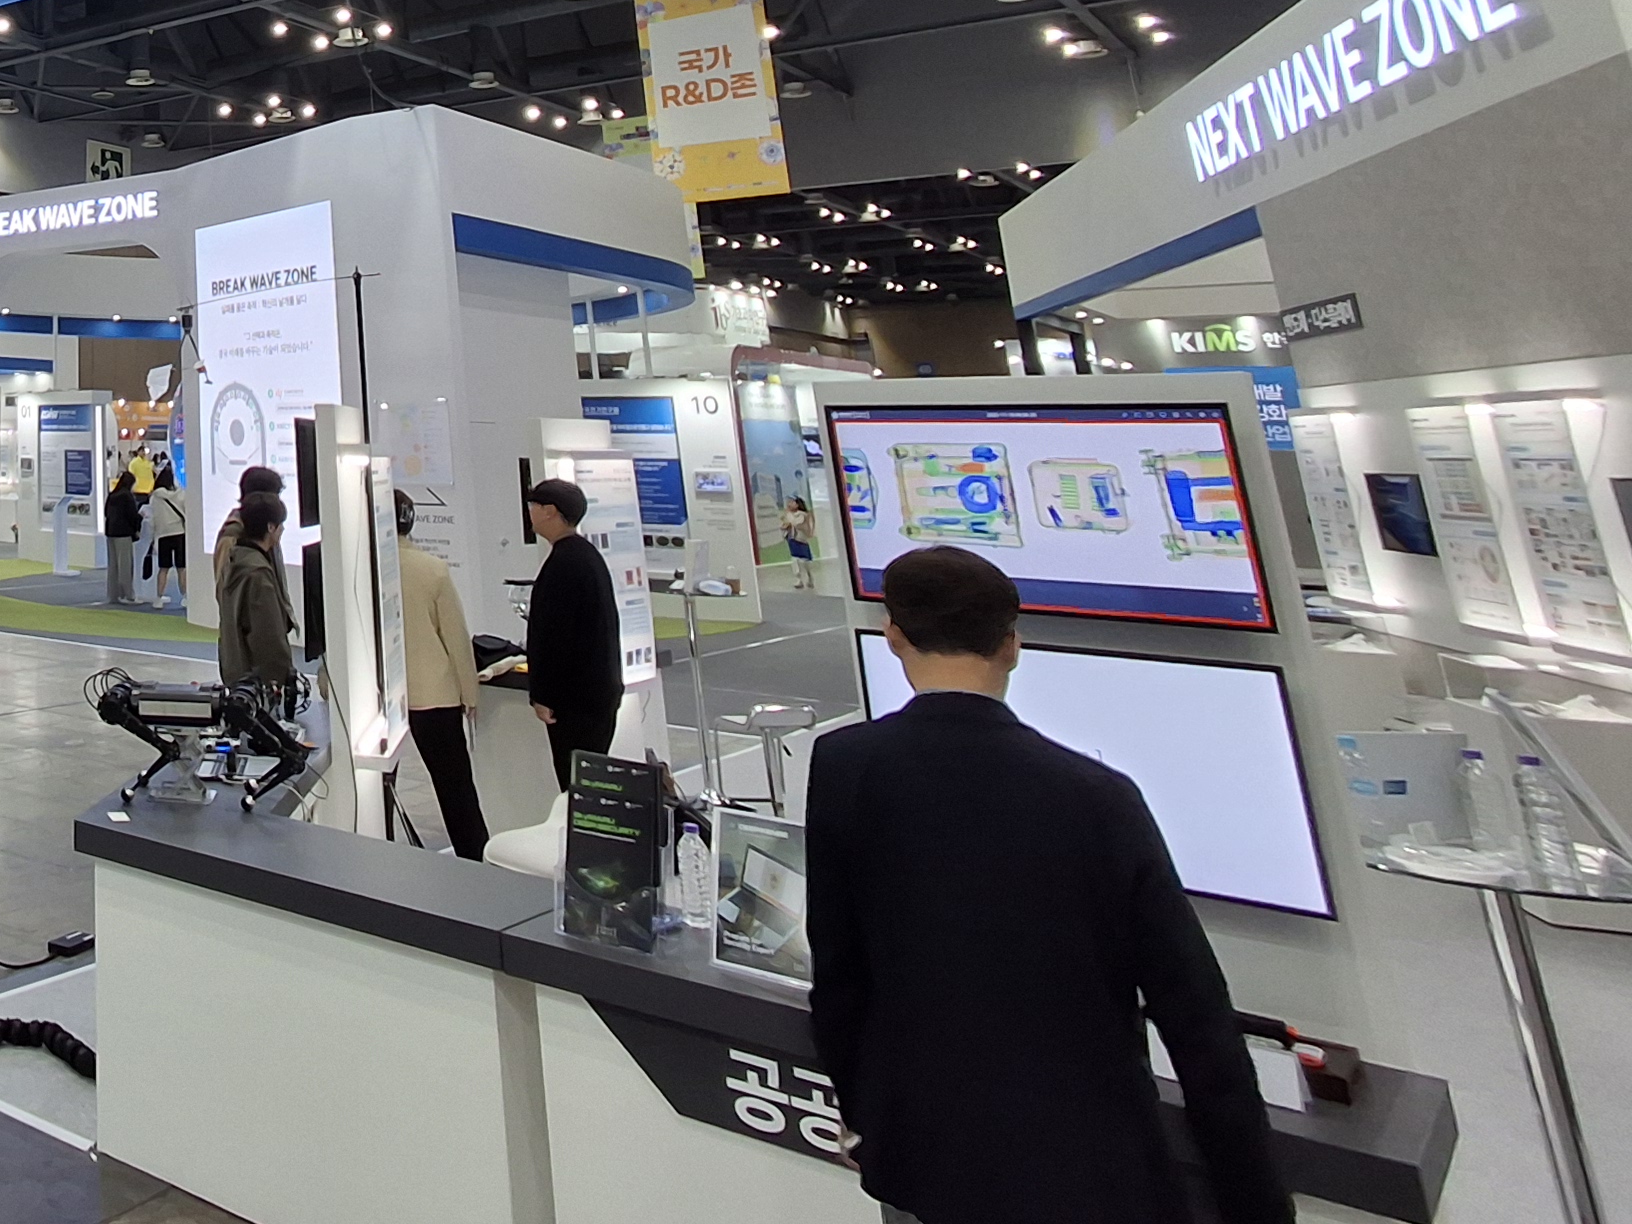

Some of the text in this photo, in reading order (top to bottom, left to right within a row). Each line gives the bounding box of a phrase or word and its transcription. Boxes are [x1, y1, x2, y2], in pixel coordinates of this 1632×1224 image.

[678, 44, 732, 73] 국가
[661, 71, 757, 109] R&D존
[1185, 82, 1264, 183] NEXT
[1257, 18, 1374, 140] WAVE
[38, 199, 96, 230] WAVE
[97, 191, 158, 224] ZONE
[211, 265, 317, 297] BREAK WAVE ZONE
[1171, 326, 1257, 353] KIMS
[21, 405, 31, 419] 01
[691, 396, 719, 415] 10
[415, 515, 455, 524] AVE ZONE
